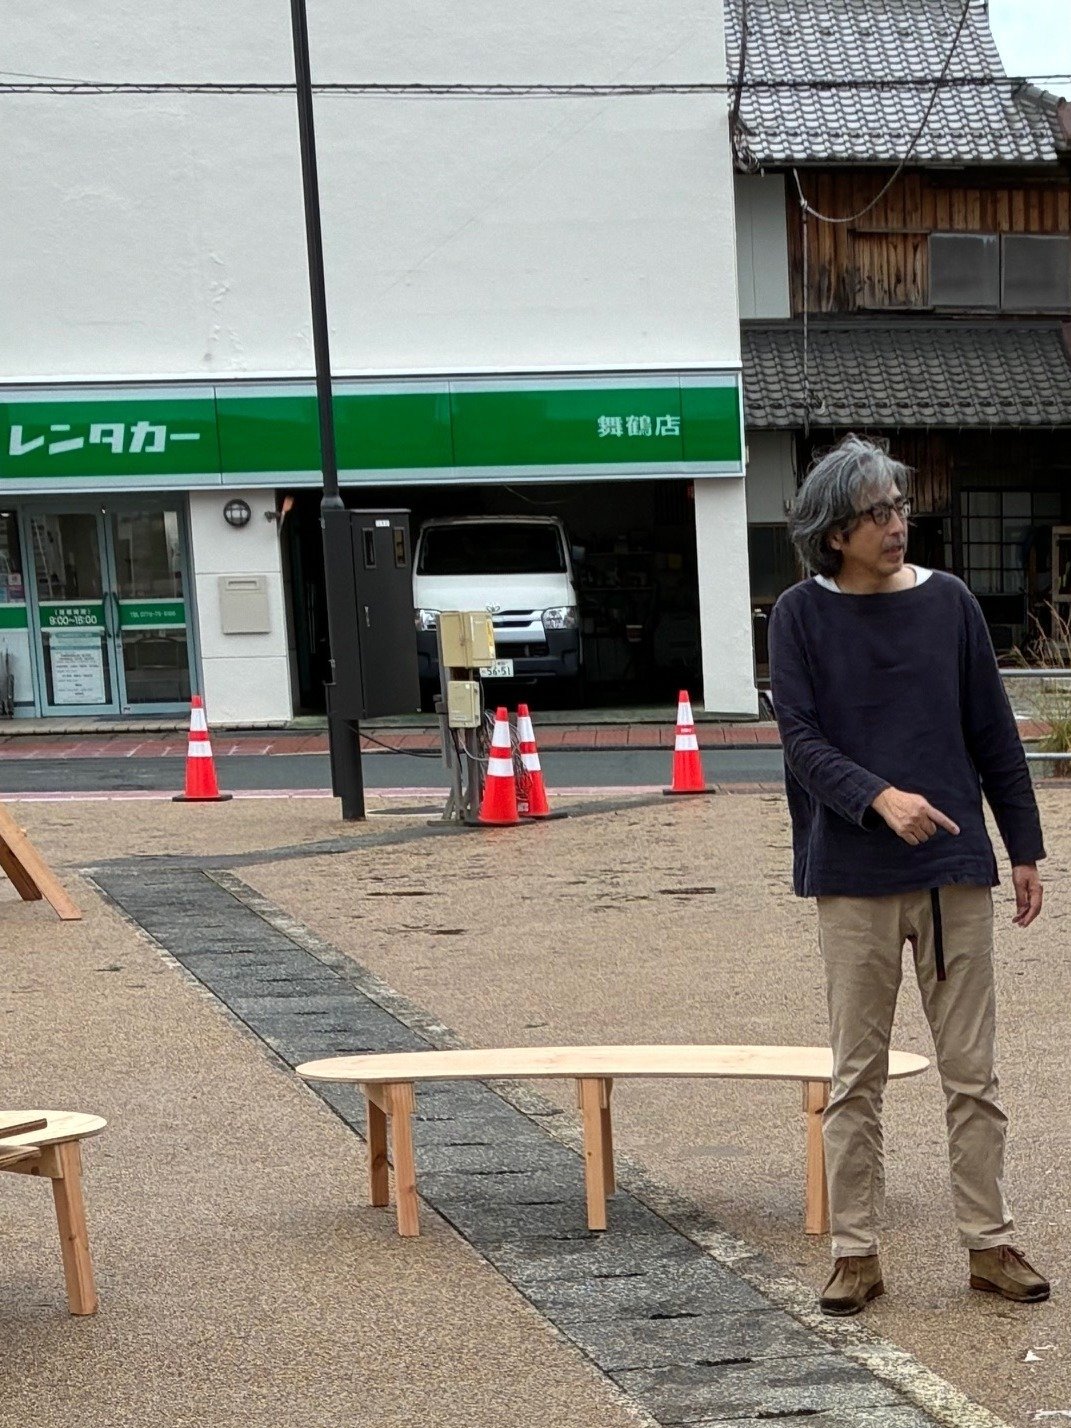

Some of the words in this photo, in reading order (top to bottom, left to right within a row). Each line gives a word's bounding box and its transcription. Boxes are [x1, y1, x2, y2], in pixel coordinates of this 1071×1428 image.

[9, 421, 200, 456] レンタカー
[597, 414, 681, 438] 舞鶴店
